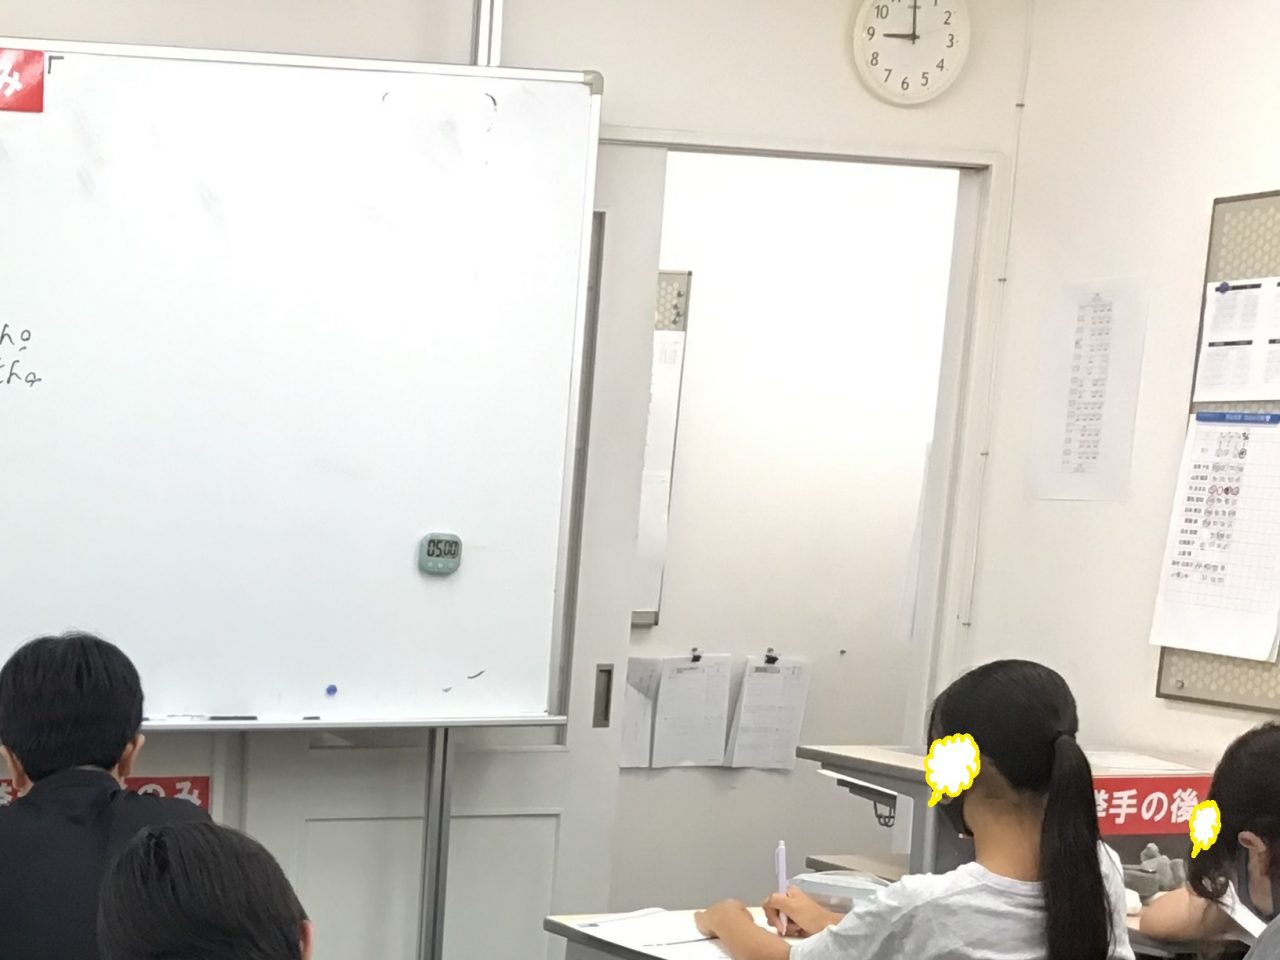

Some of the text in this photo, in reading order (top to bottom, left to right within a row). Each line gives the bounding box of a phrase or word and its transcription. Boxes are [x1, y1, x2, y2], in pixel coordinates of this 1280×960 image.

[875, 4, 889, 19] 10
[943, 10, 952, 25] 2
[867, 26, 875, 40] 9
[946, 33, 954, 48] 3
[870, 51, 879, 66] 8
[936, 58, 944, 72] 4
[884, 68, 893, 83] 7
[921, 71, 929, 86] 5
[901, 76, 909, 91] 6
